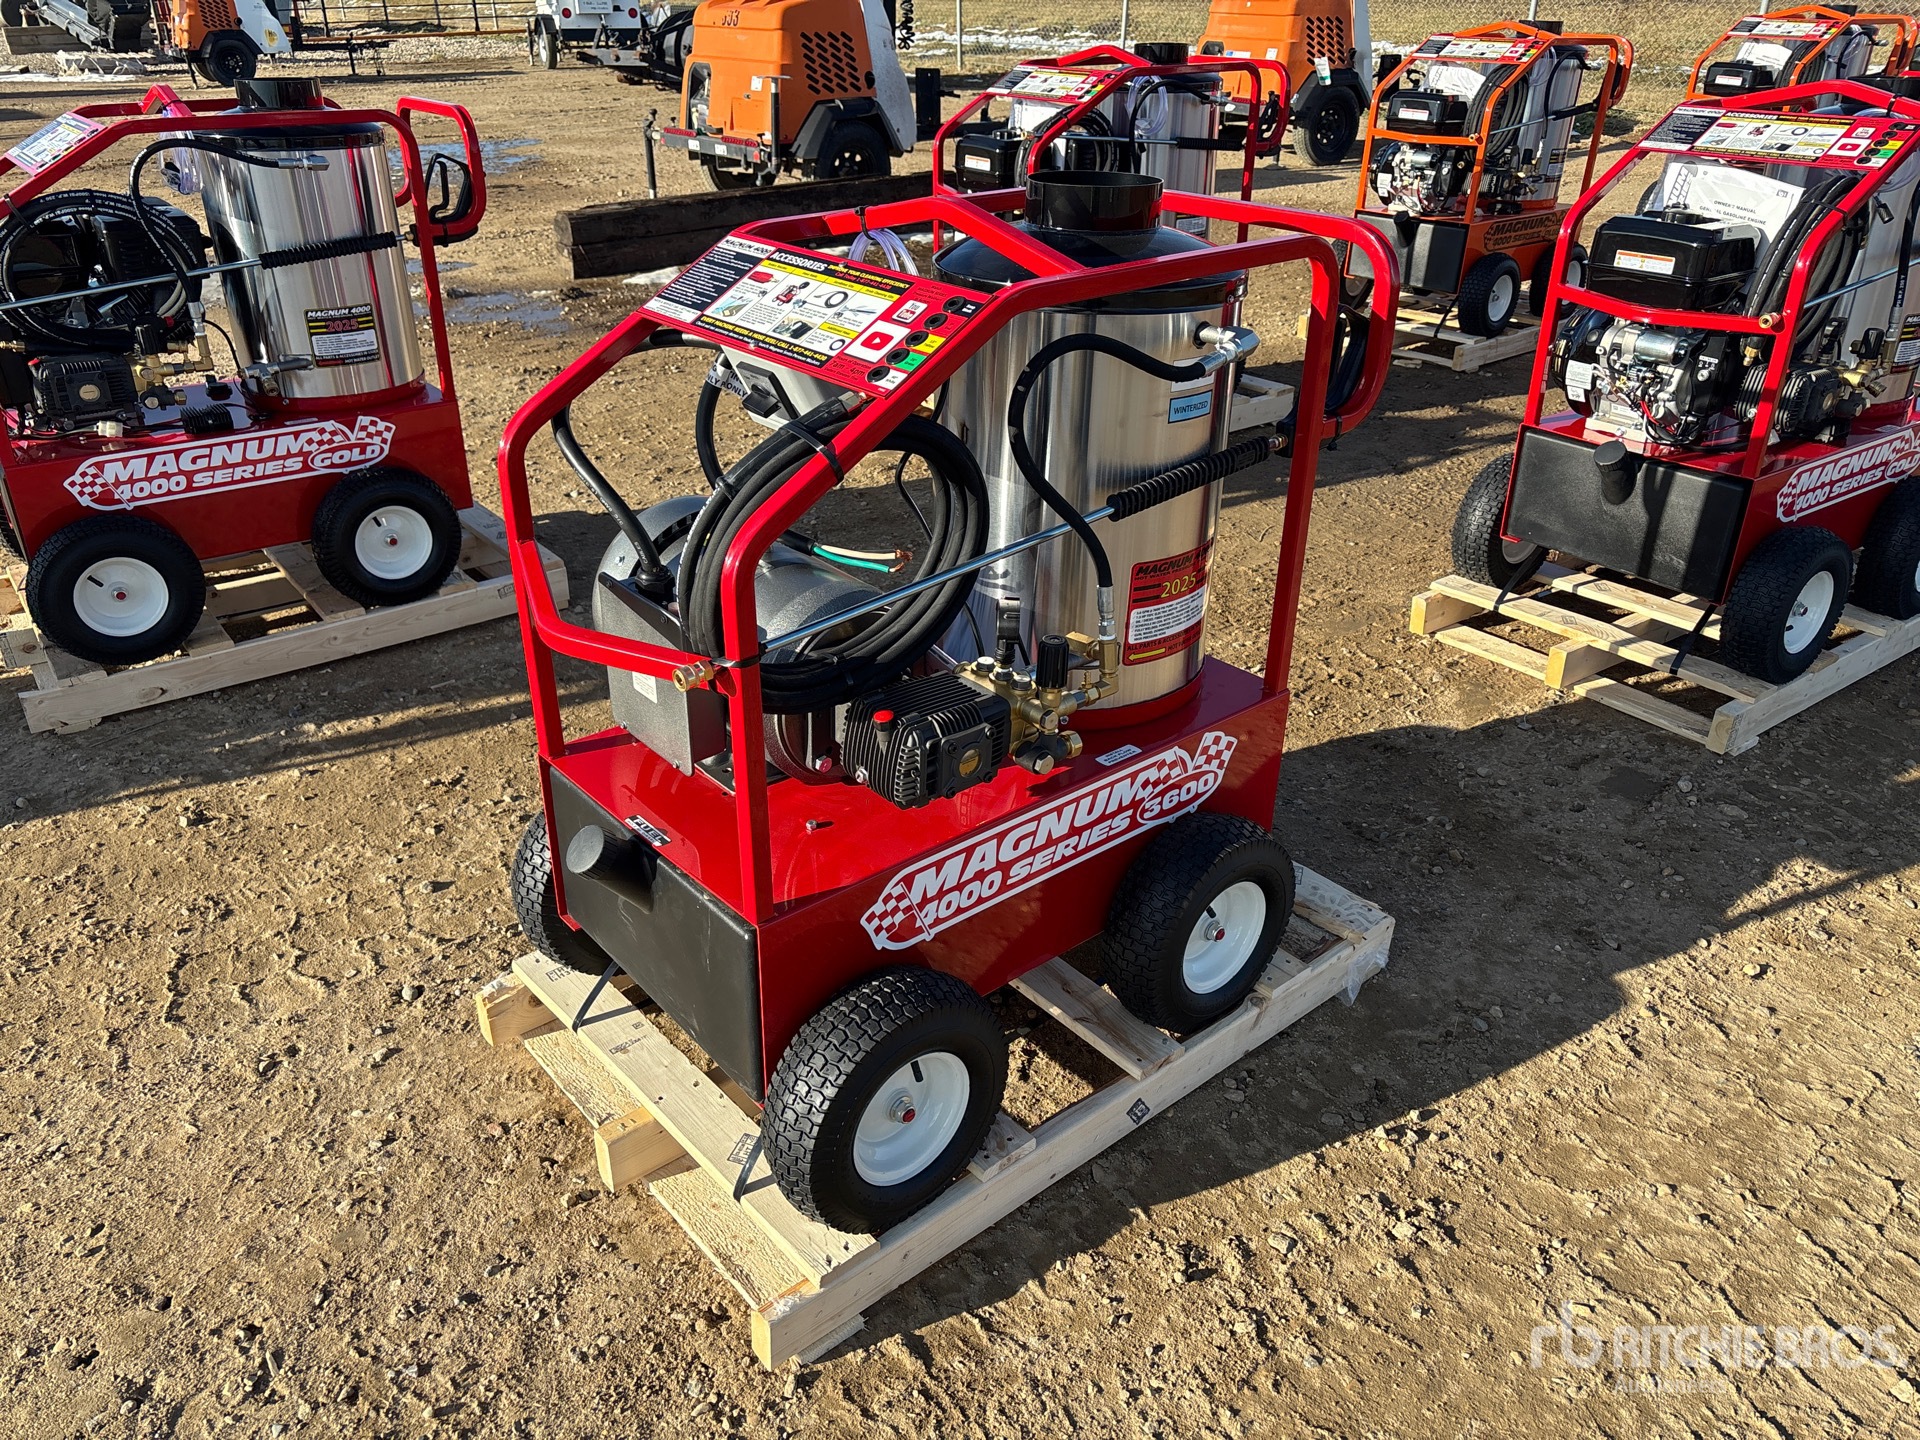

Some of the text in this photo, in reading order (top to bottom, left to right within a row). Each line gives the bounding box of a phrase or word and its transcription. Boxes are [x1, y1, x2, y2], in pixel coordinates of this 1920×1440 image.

[1723, 111, 1780, 120] ACCESSORIES
[1722, 211, 1767, 226] GASOLINE ENGINE
[1736, 206, 1757, 214] MANUAL
[1494, 216, 1550, 237] MAGNUM
[768, 250, 829, 272] ACCESSORIES
[880, 278, 911, 289] EFFICIENCY
[307, 305, 371, 318] MAGNUM 4000
[896, 309, 916, 319] Tube
[906, 302, 922, 311] You
[325, 319, 359, 332] 2025
[699, 315, 717, 324] EVERY
[775, 340, 791, 349] CALL
[827, 359, 867, 378] 7am 4pm
[726, 382, 748, 397] ONLY
[1173, 400, 1209, 415] WINTERIZED
[103, 431, 309, 484] MAGNUM
[114, 445, 381, 500] 4000 SERIES GOLD
[1796, 442, 1896, 494] MAGNUM
[1828, 465, 1887, 498] SERIES
[1886, 453, 1920, 477] GOLD
[1135, 554, 1194, 577] MAGNUM
[1149, 571, 1171, 579] WATER
[1160, 572, 1197, 598] 2025
[1127, 643, 1139, 652] ALL
[1139, 640, 1158, 650] PARTS
[633, 818, 662, 843] FUEL
[908, 766, 1160, 902] MAGNUM
[915, 773, 1216, 929] 4000 SERIES 3600
